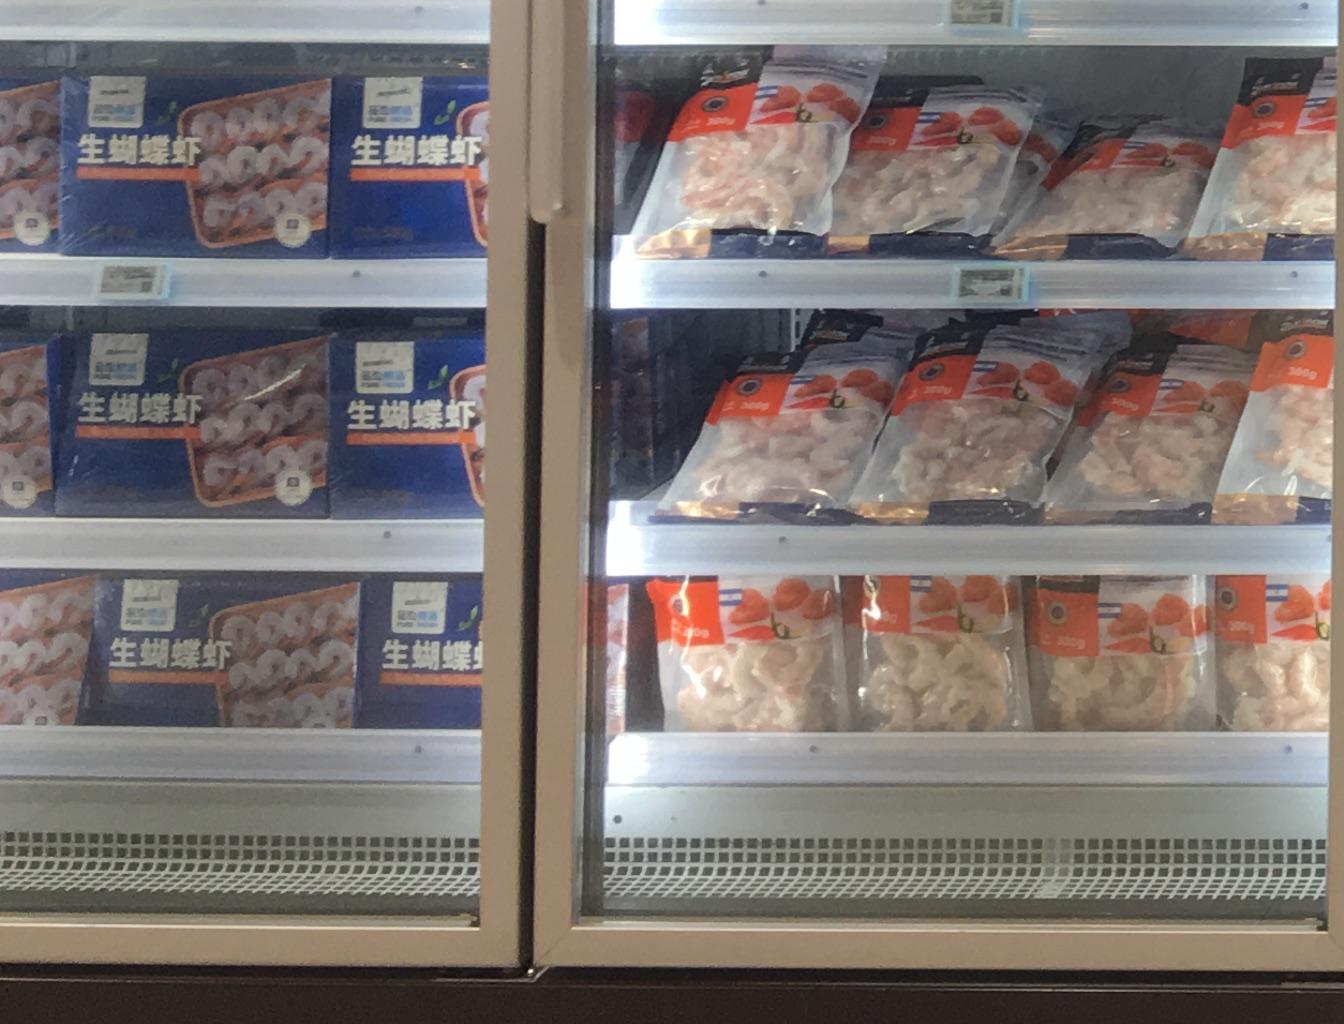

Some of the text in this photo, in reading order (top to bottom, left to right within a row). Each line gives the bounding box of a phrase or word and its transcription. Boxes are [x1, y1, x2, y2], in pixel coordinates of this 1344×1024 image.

[78, 134, 200, 166] 生蝴蝶虾
[351, 134, 481, 166] 生蝴蝶虾
[78, 392, 203, 425] 生蝴蝶虾
[348, 400, 476, 430] 生蝴蝶虾
[110, 638, 232, 669] 生蝴蝶虾
